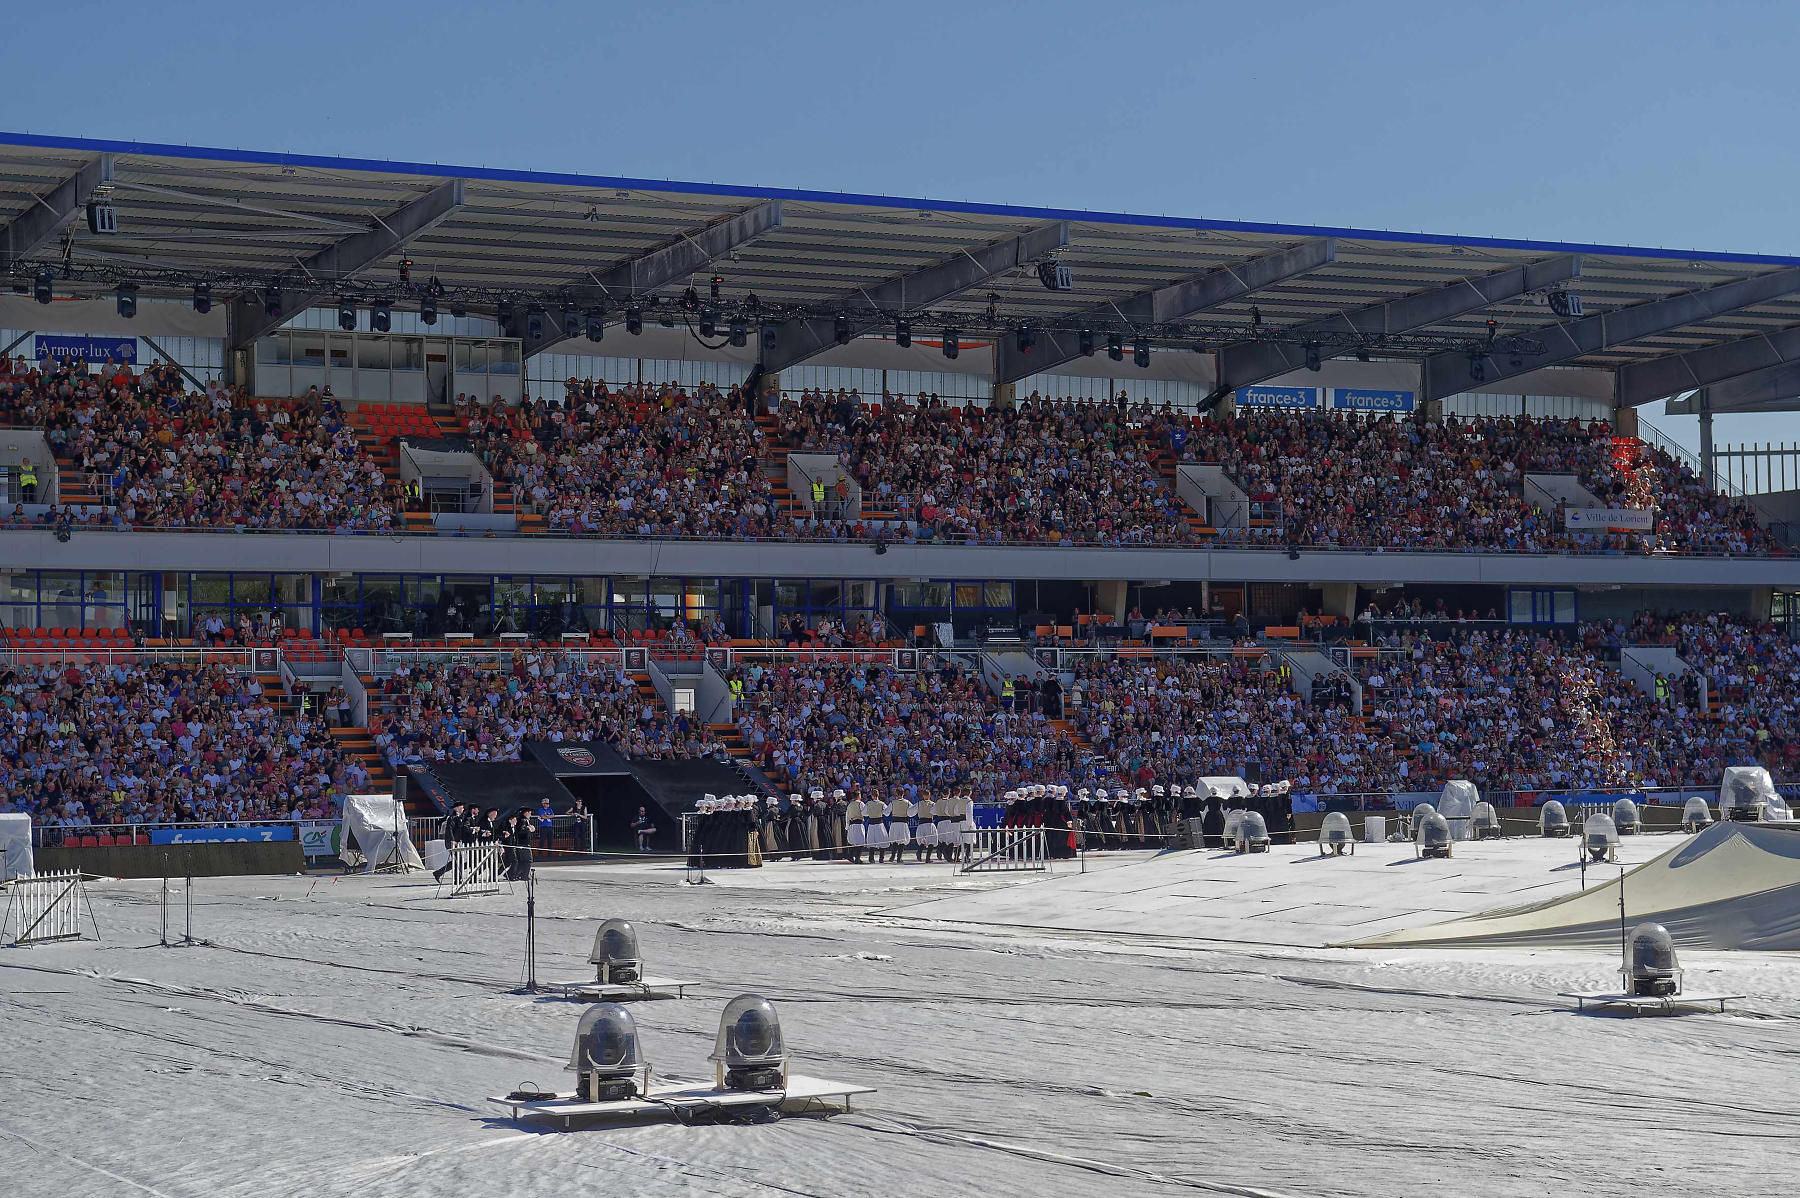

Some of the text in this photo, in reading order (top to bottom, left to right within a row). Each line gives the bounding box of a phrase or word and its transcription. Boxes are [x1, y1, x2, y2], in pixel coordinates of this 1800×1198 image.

[1586, 513, 1648, 524] Ville de Lorient
